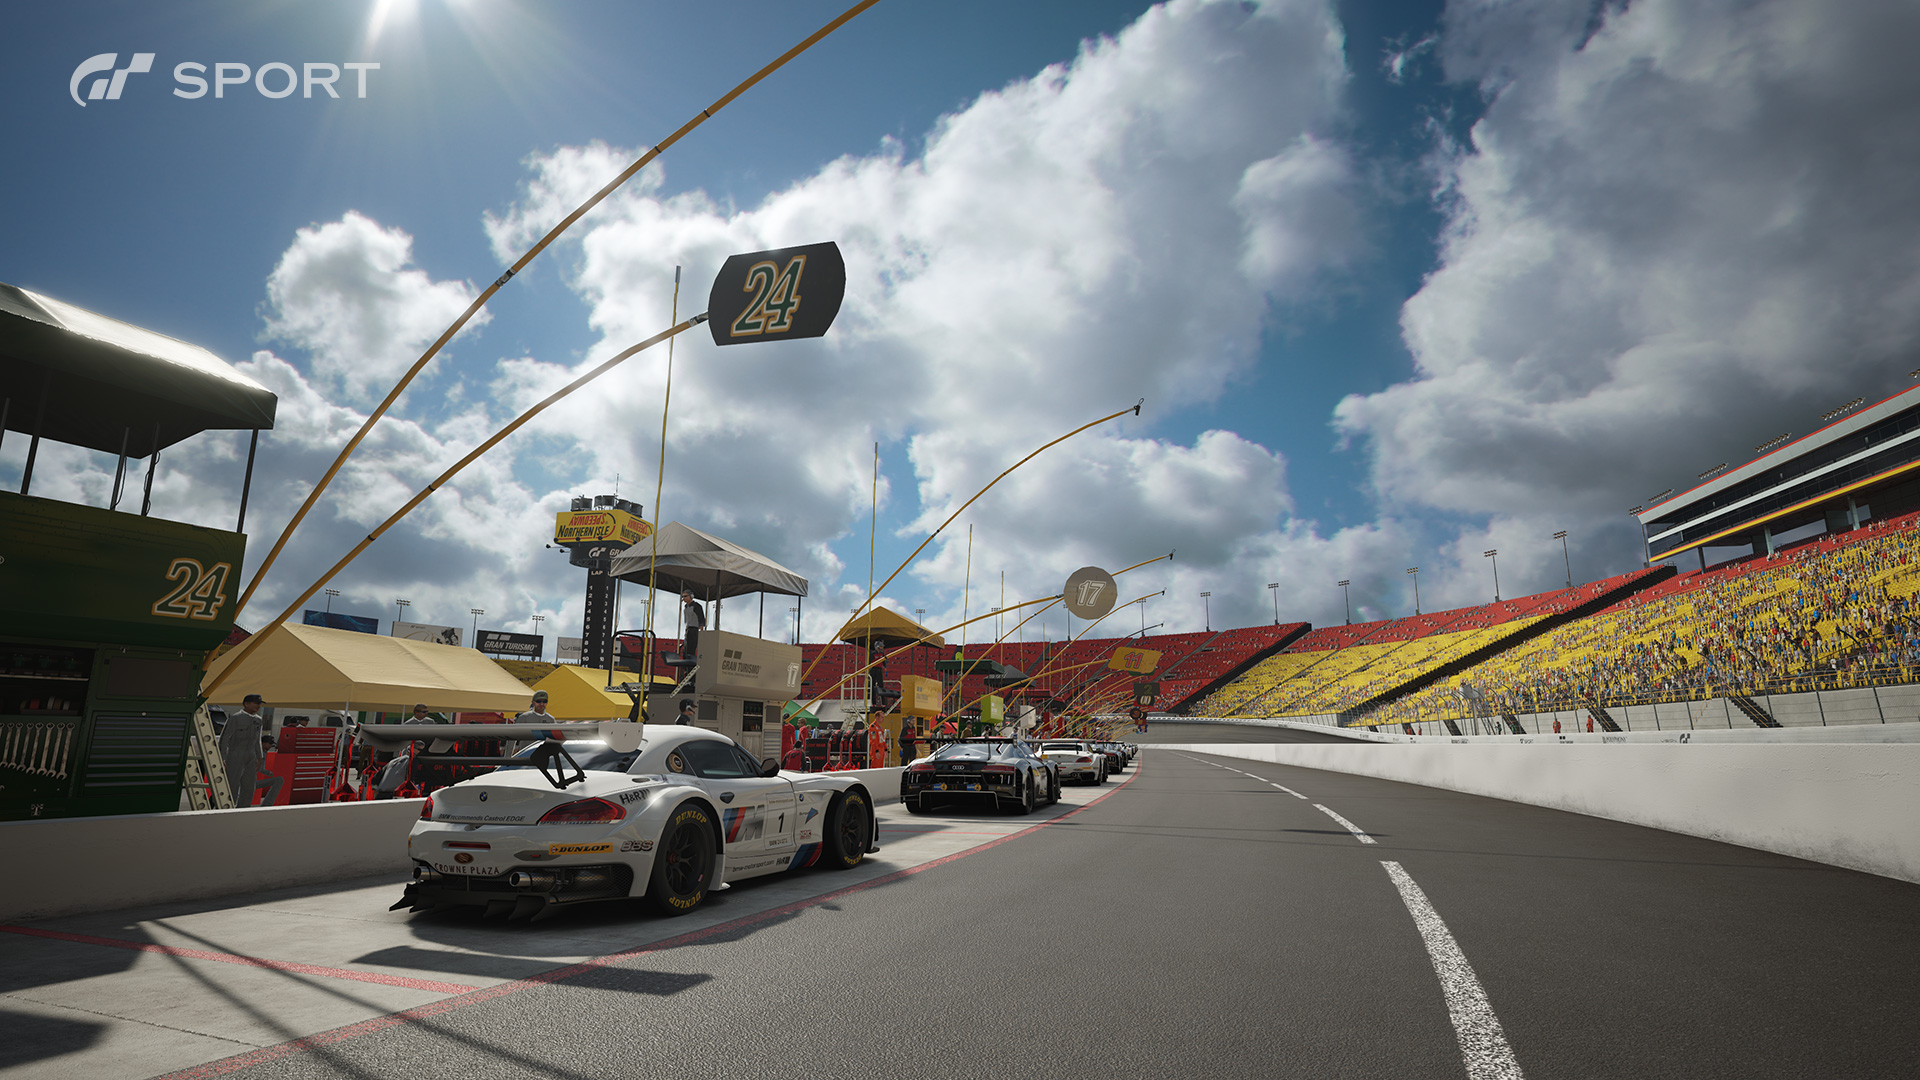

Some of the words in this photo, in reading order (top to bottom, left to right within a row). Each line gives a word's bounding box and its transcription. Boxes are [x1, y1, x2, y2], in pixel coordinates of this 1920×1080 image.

[730, 254, 807, 337] 24
[151, 557, 231, 621] 24
[1077, 580, 1107, 607] 17
[484, 641, 505, 649] GRAN
[722, 660, 737, 671] GRAN
[1124, 652, 1143, 668] 11
[787, 662, 799, 688] 17
[675, 810, 707, 826] DUNLOP
[778, 812, 785, 833] 1
[558, 844, 611, 853] DUNLOP
[620, 841, 654, 852] BBS
[434, 862, 469, 874] CROWNE
[470, 866, 500, 875] PLAZA
[669, 890, 701, 908] DUNLOP
